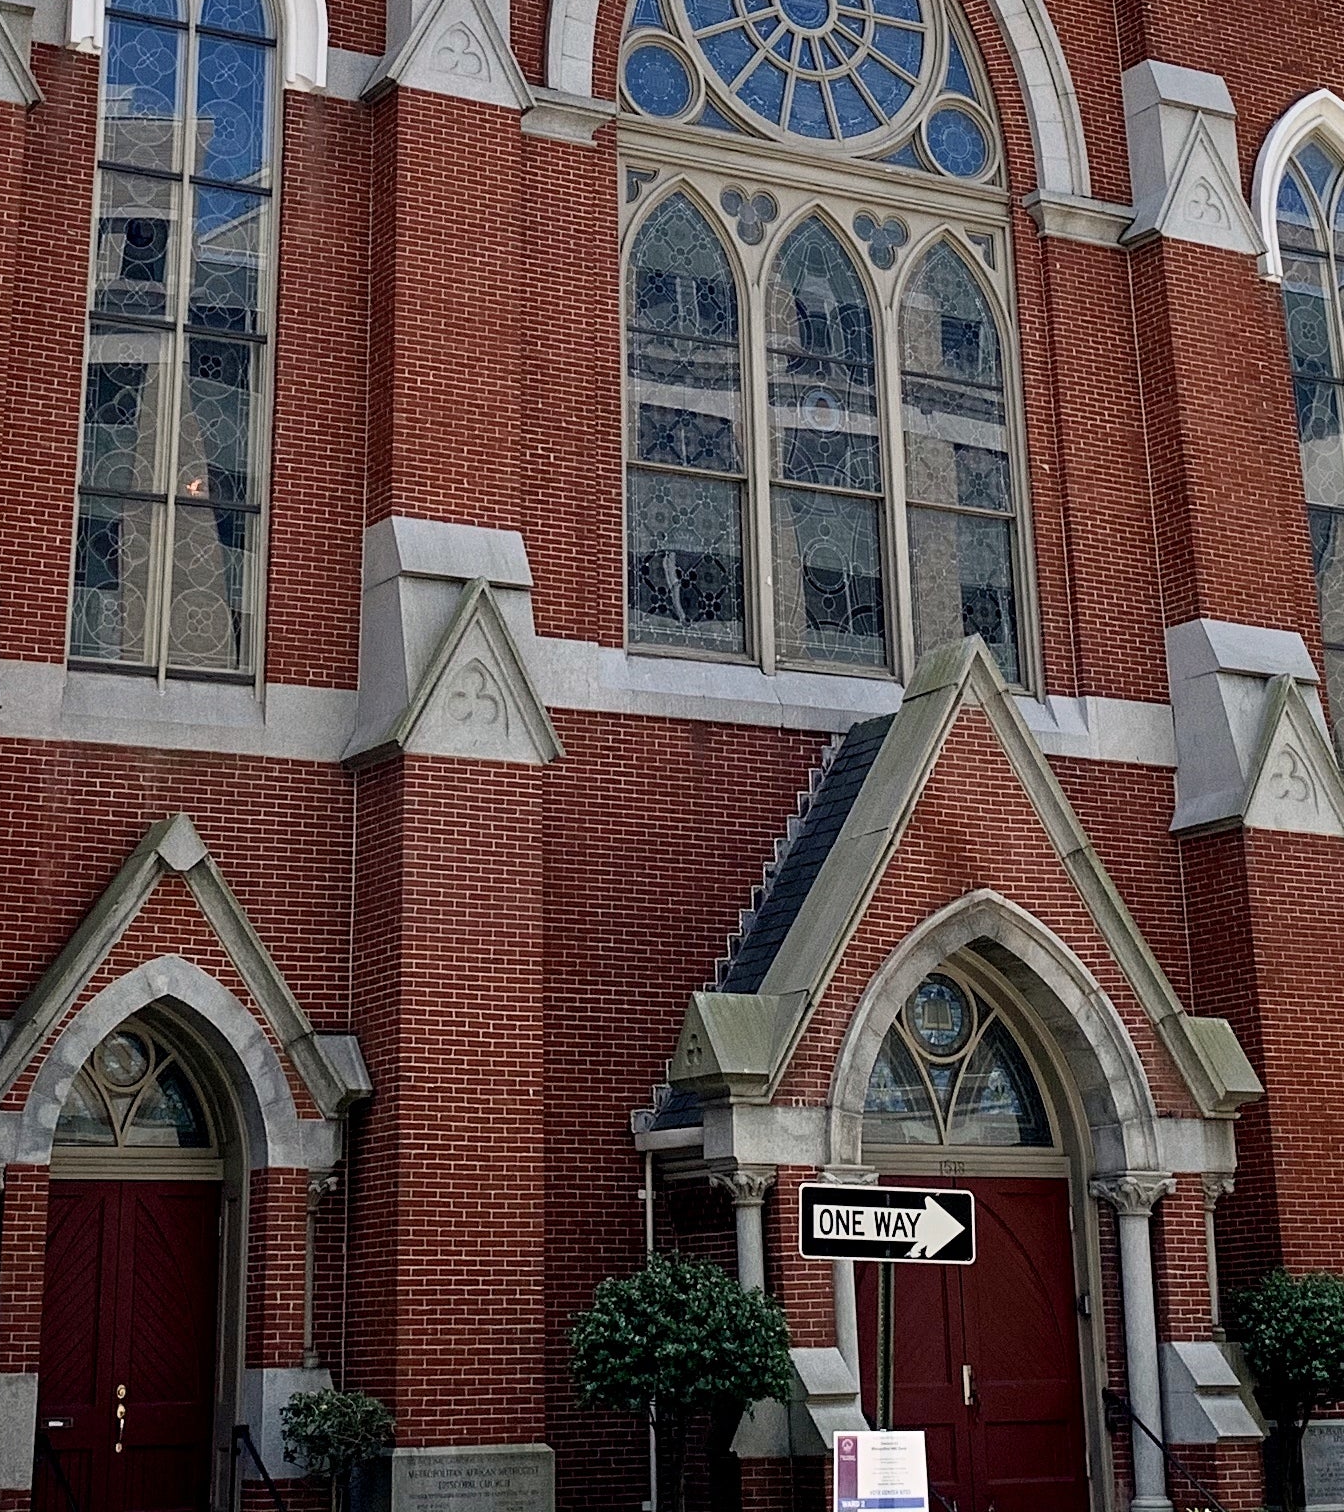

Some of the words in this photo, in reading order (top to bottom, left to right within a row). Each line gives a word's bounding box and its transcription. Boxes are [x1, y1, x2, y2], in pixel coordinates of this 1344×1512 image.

[939, 1160, 965, 1175] 1518
[819, 1208, 865, 1236] ONE
[874, 1211, 922, 1238] WAY
[841, 1500, 860, 1508] WARD
